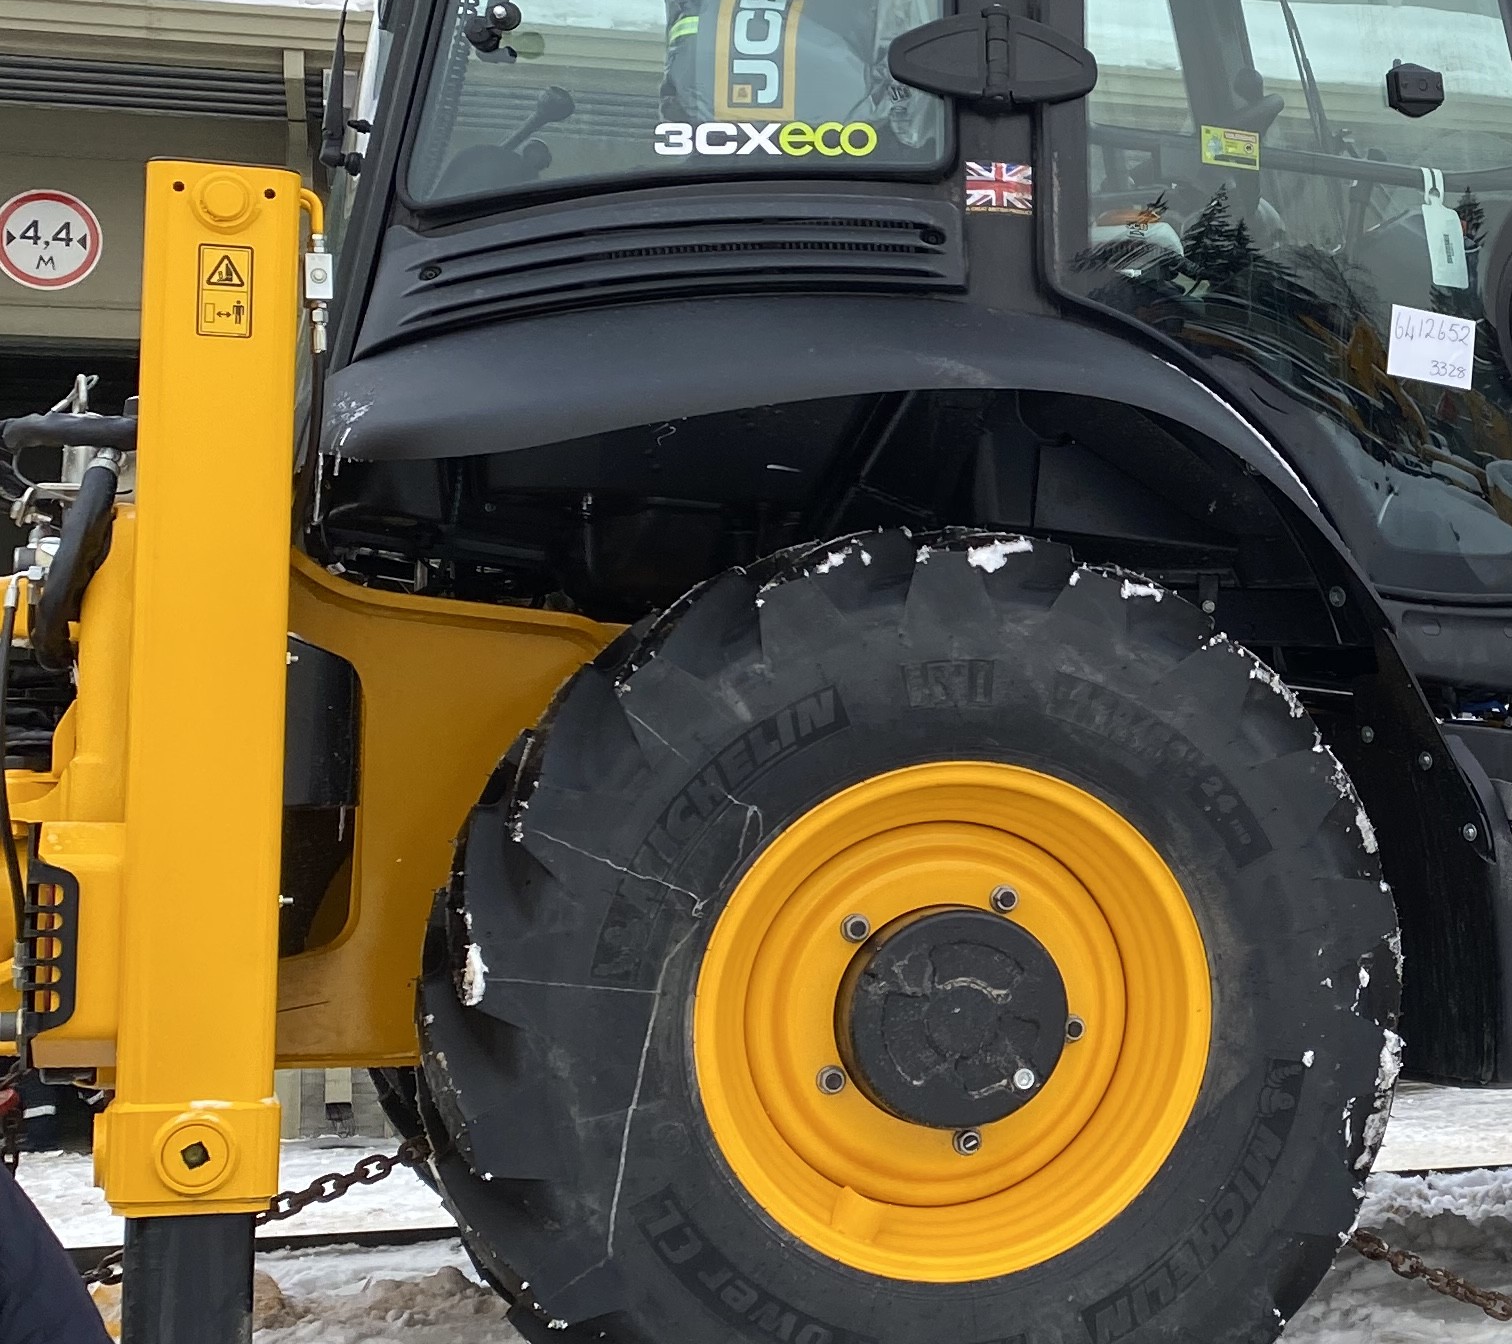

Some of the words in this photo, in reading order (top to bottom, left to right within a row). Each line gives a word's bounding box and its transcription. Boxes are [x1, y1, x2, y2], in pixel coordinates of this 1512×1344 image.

[654, 122, 878, 157] 3CXeco
[20, 220, 73, 250] 4,4
[1395, 312, 1471, 346] 6412652
[1429, 359, 1467, 378] 3328
[620, 686, 842, 911] MICHELIN
[1085, 1127, 1287, 1344] MICHELIN
